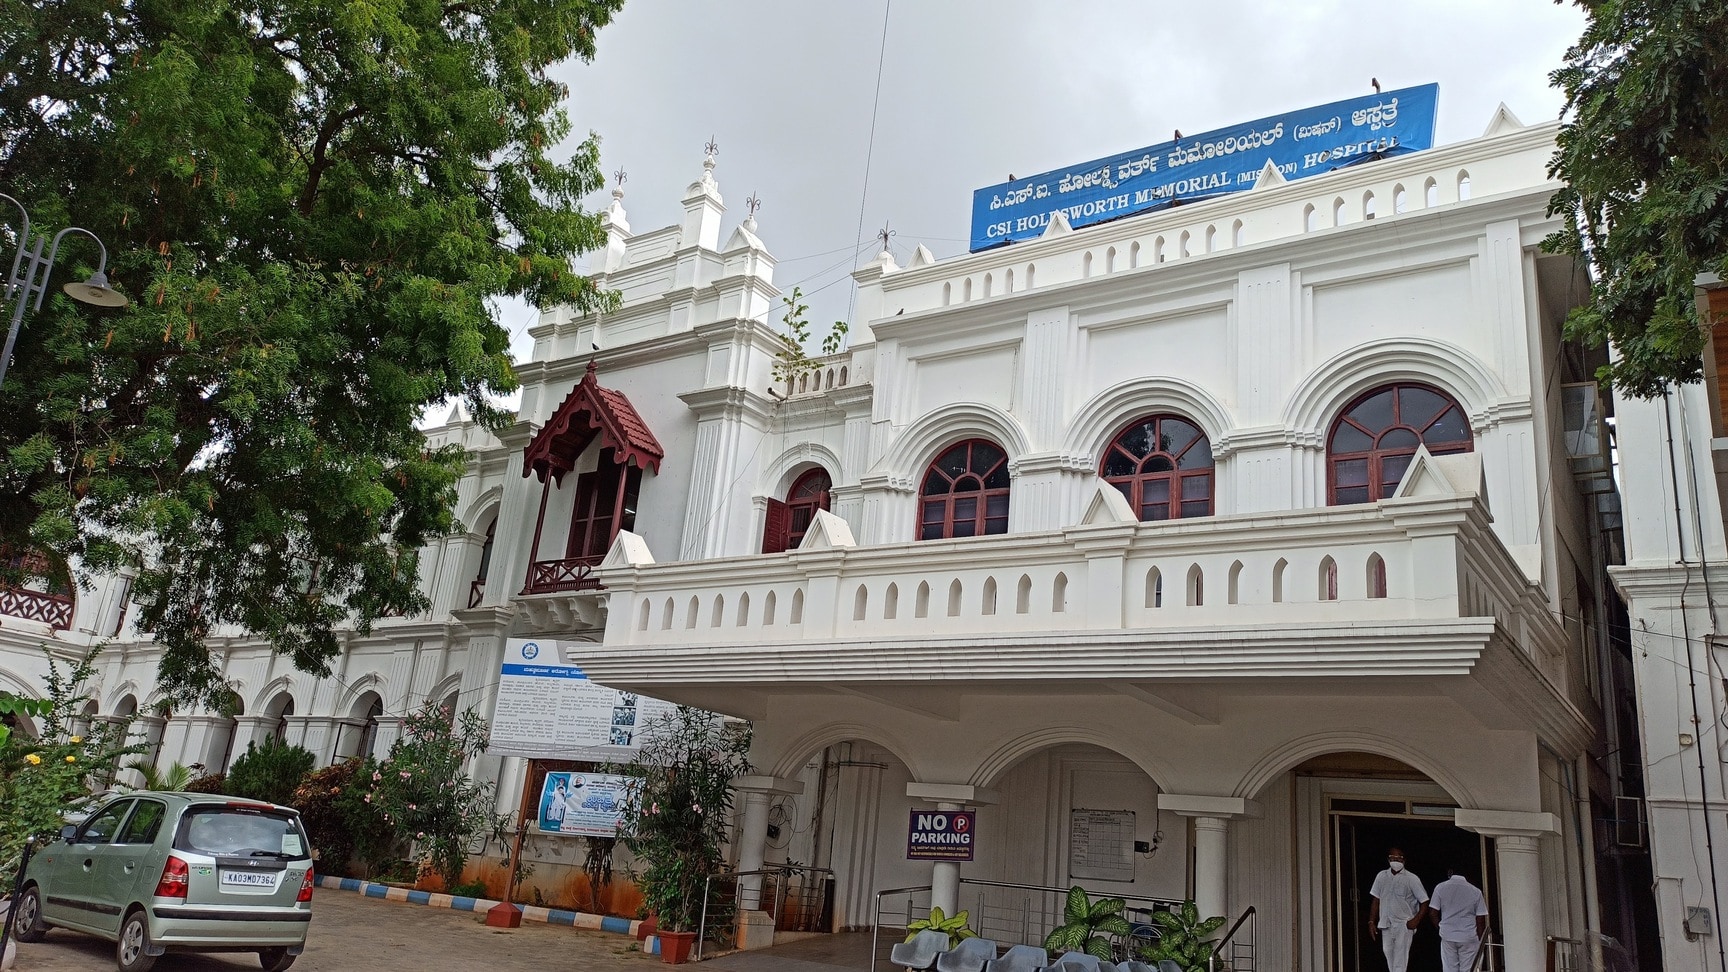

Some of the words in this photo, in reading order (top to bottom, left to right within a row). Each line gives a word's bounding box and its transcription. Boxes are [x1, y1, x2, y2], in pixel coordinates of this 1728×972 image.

[986, 220, 1011, 238] CSI
[1236, 162, 1297, 186] (MISON)
[1302, 135, 1400, 169] HOSPITAL
[917, 814, 947, 831] NO
[911, 832, 970, 844] PARKING
